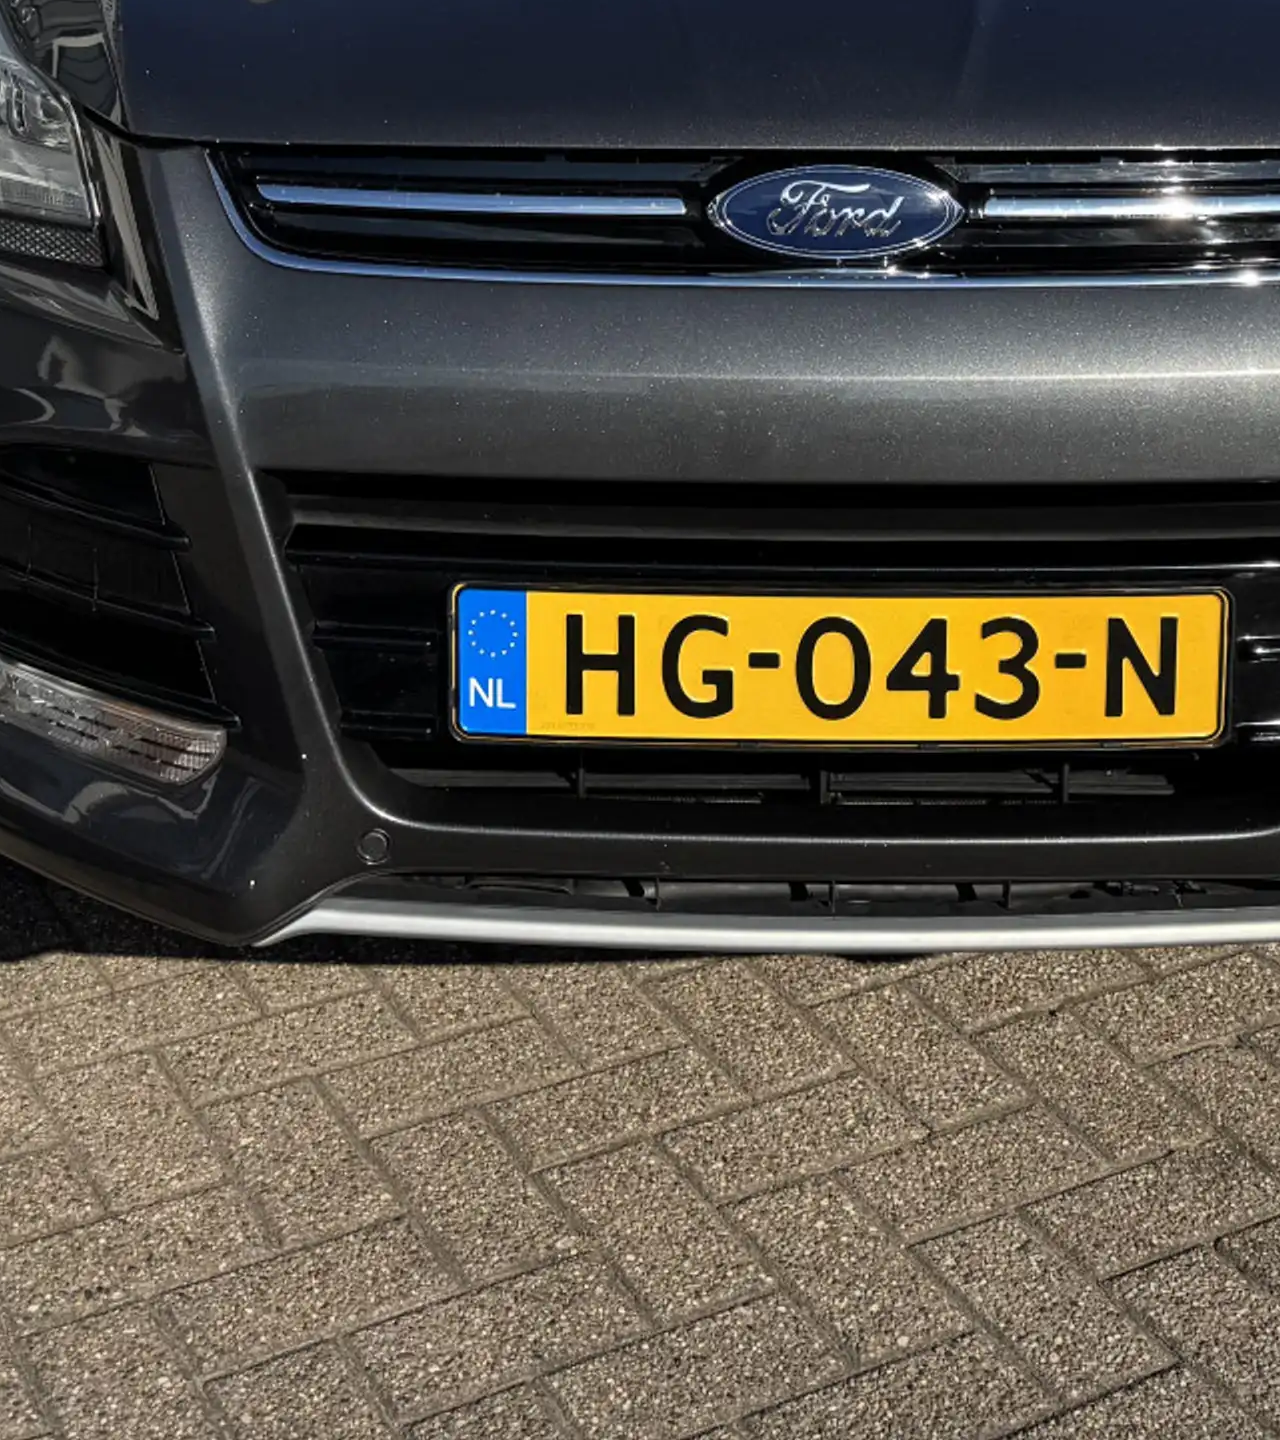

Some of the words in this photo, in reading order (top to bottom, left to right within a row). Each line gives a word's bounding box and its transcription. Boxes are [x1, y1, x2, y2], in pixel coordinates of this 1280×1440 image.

[766, 179, 904, 237] Ford
[469, 676, 516, 709] NL
[564, 613, 1179, 720] HG-043-N
